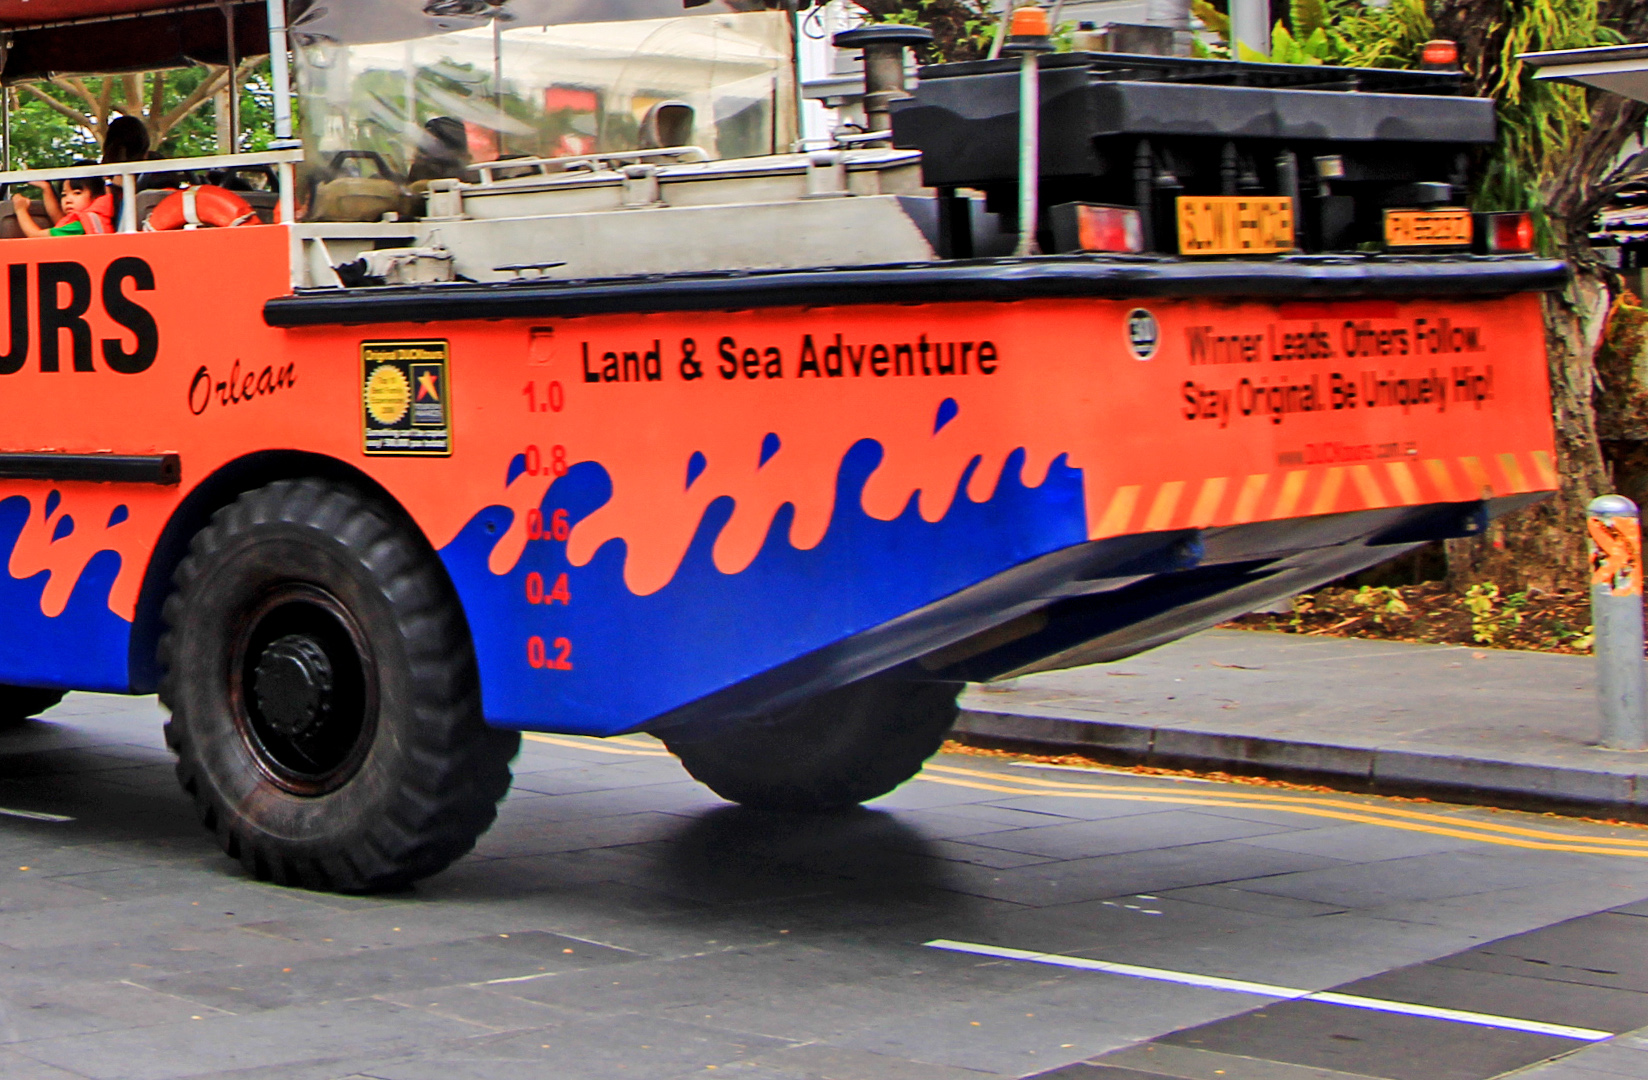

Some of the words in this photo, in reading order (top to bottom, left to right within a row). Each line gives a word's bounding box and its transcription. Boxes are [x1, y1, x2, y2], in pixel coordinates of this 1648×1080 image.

[581, 338, 663, 384] Land
[679, 337, 704, 381] &
[717, 336, 783, 380] Sea
[796, 333, 1000, 379] Adventure
[1184, 325, 1264, 366] Winner
[187, 356, 298, 416] Orlean
[521, 380, 565, 413] 1.0
[1181, 379, 1233, 429] Stay
[1329, 372, 1357, 410] Be
[1360, 367, 1449, 415] Uniquely
[524, 444, 569, 477] 0.8
[525, 509, 570, 542] 0.6
[525, 572, 571, 606] 0.4
[526, 636, 574, 671] 0.2
